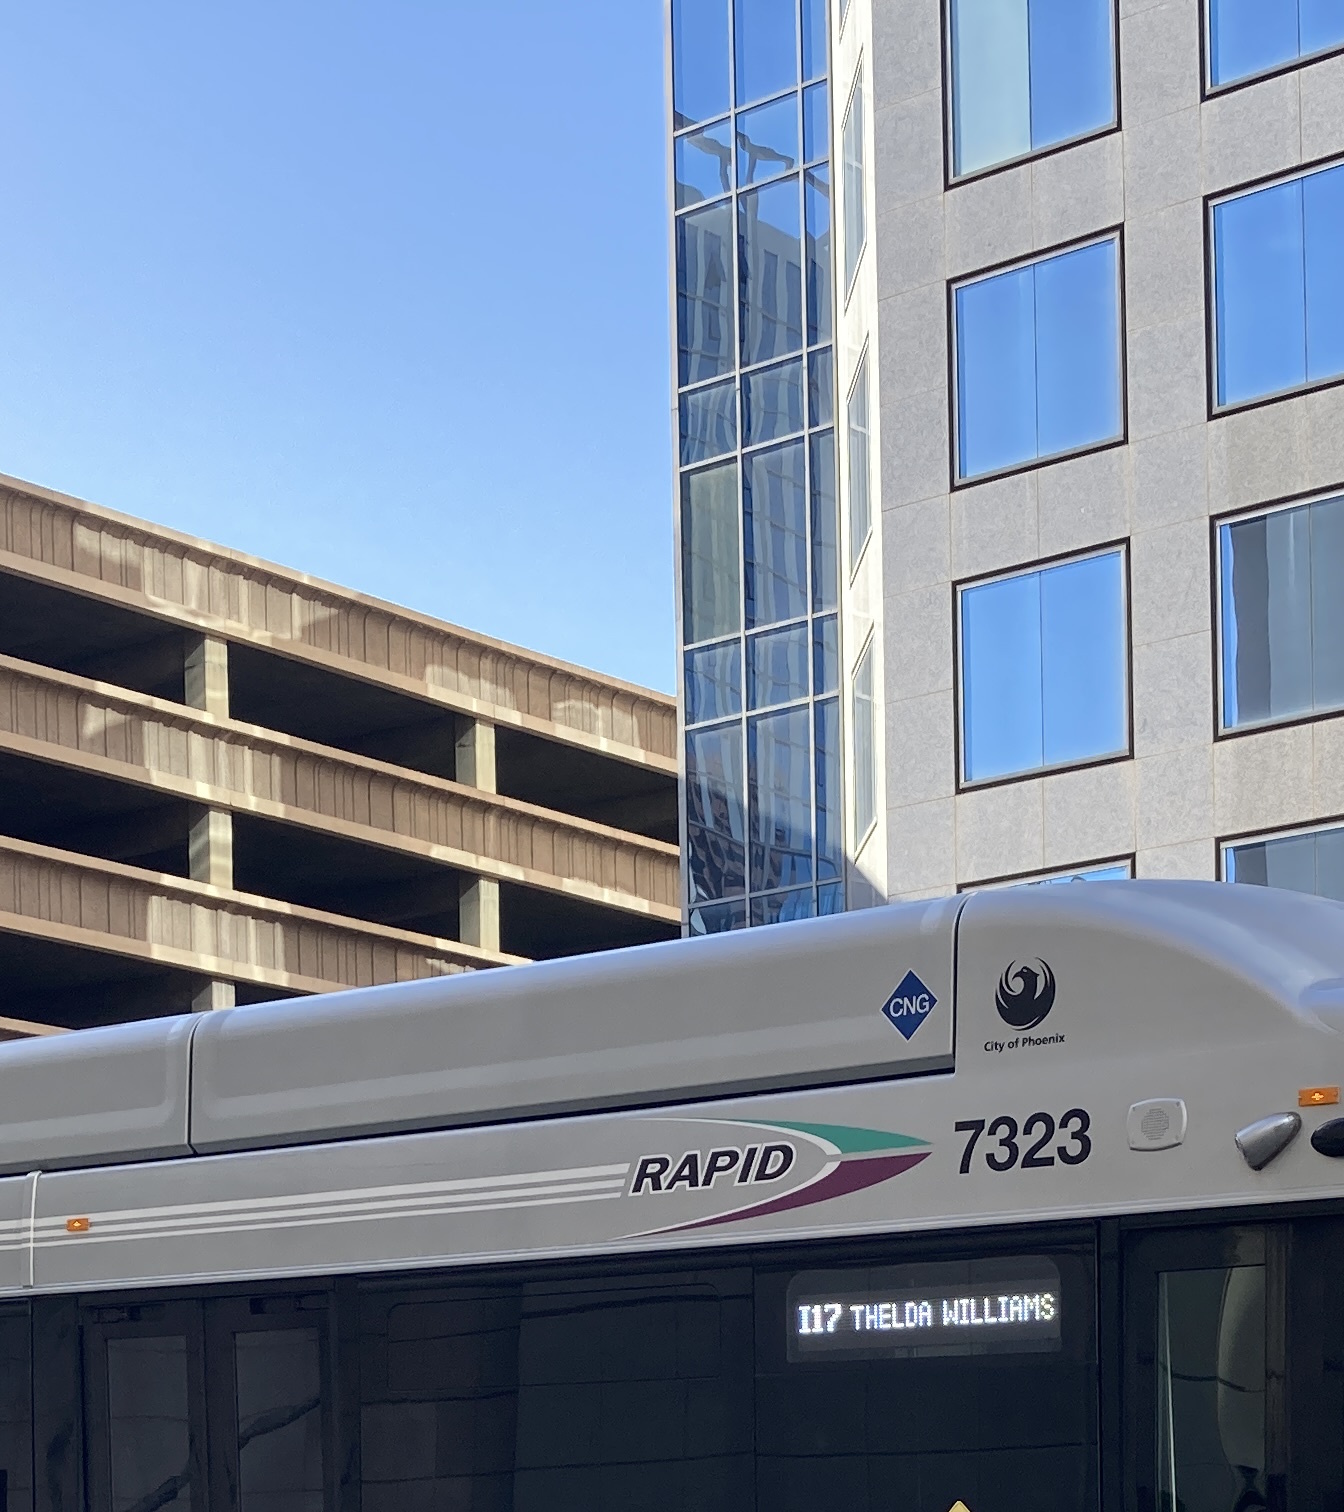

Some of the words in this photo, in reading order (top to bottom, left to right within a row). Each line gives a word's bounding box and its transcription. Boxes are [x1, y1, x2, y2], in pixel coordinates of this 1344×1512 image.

[889, 993, 930, 1018] CNG
[984, 1040, 1005, 1053] City
[1007, 1037, 1020, 1049] of
[1022, 1033, 1066, 1047] Phoenix
[954, 1108, 1092, 1174] 7323
[630, 1142, 795, 1195] RAPID
[849, 1300, 932, 1331] THELDA
[942, 1293, 1056, 1327] WILLIAMS
